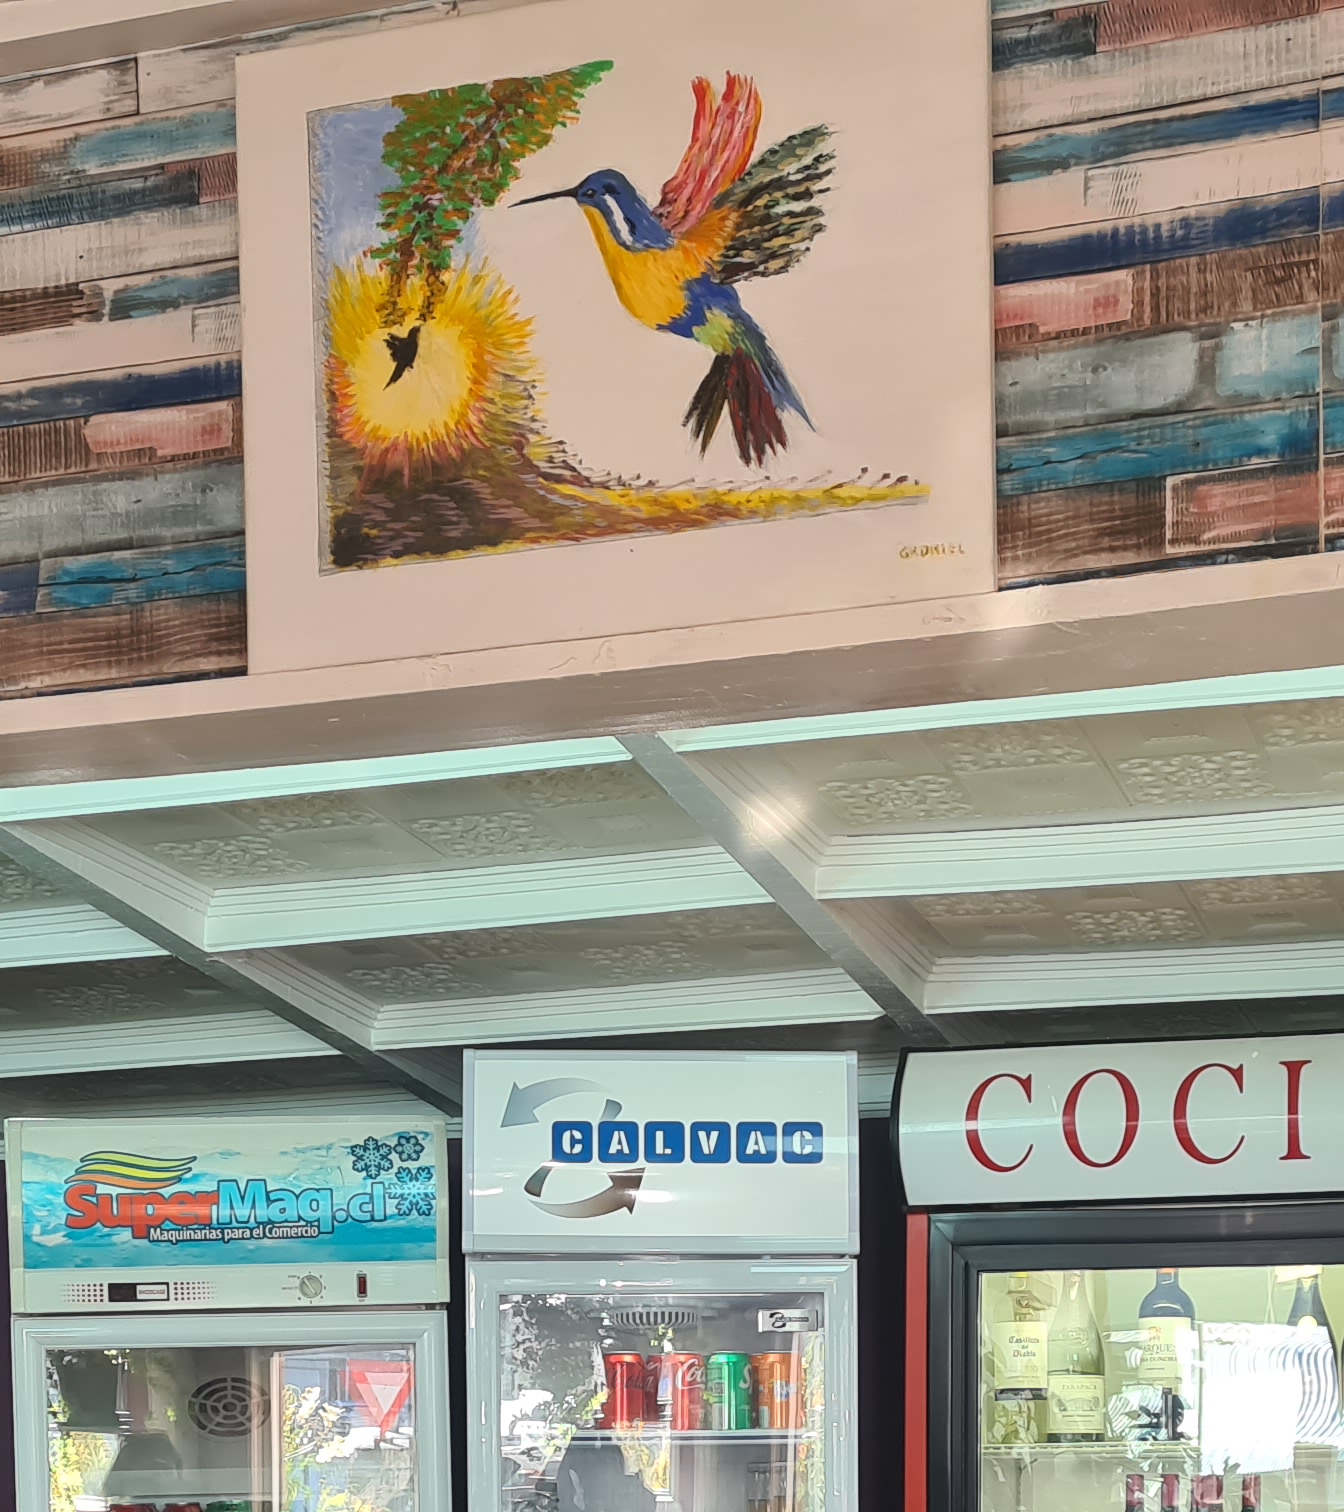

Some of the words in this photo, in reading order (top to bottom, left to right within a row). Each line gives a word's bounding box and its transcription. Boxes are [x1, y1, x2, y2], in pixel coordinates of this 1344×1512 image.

[560, 1128, 815, 1156] CALVAC
[149, 1225, 222, 1242] Maquinarias
[223, 1227, 250, 1241] para
[252, 1225, 265, 1239] el
[265, 1223, 319, 1239] Comercio
